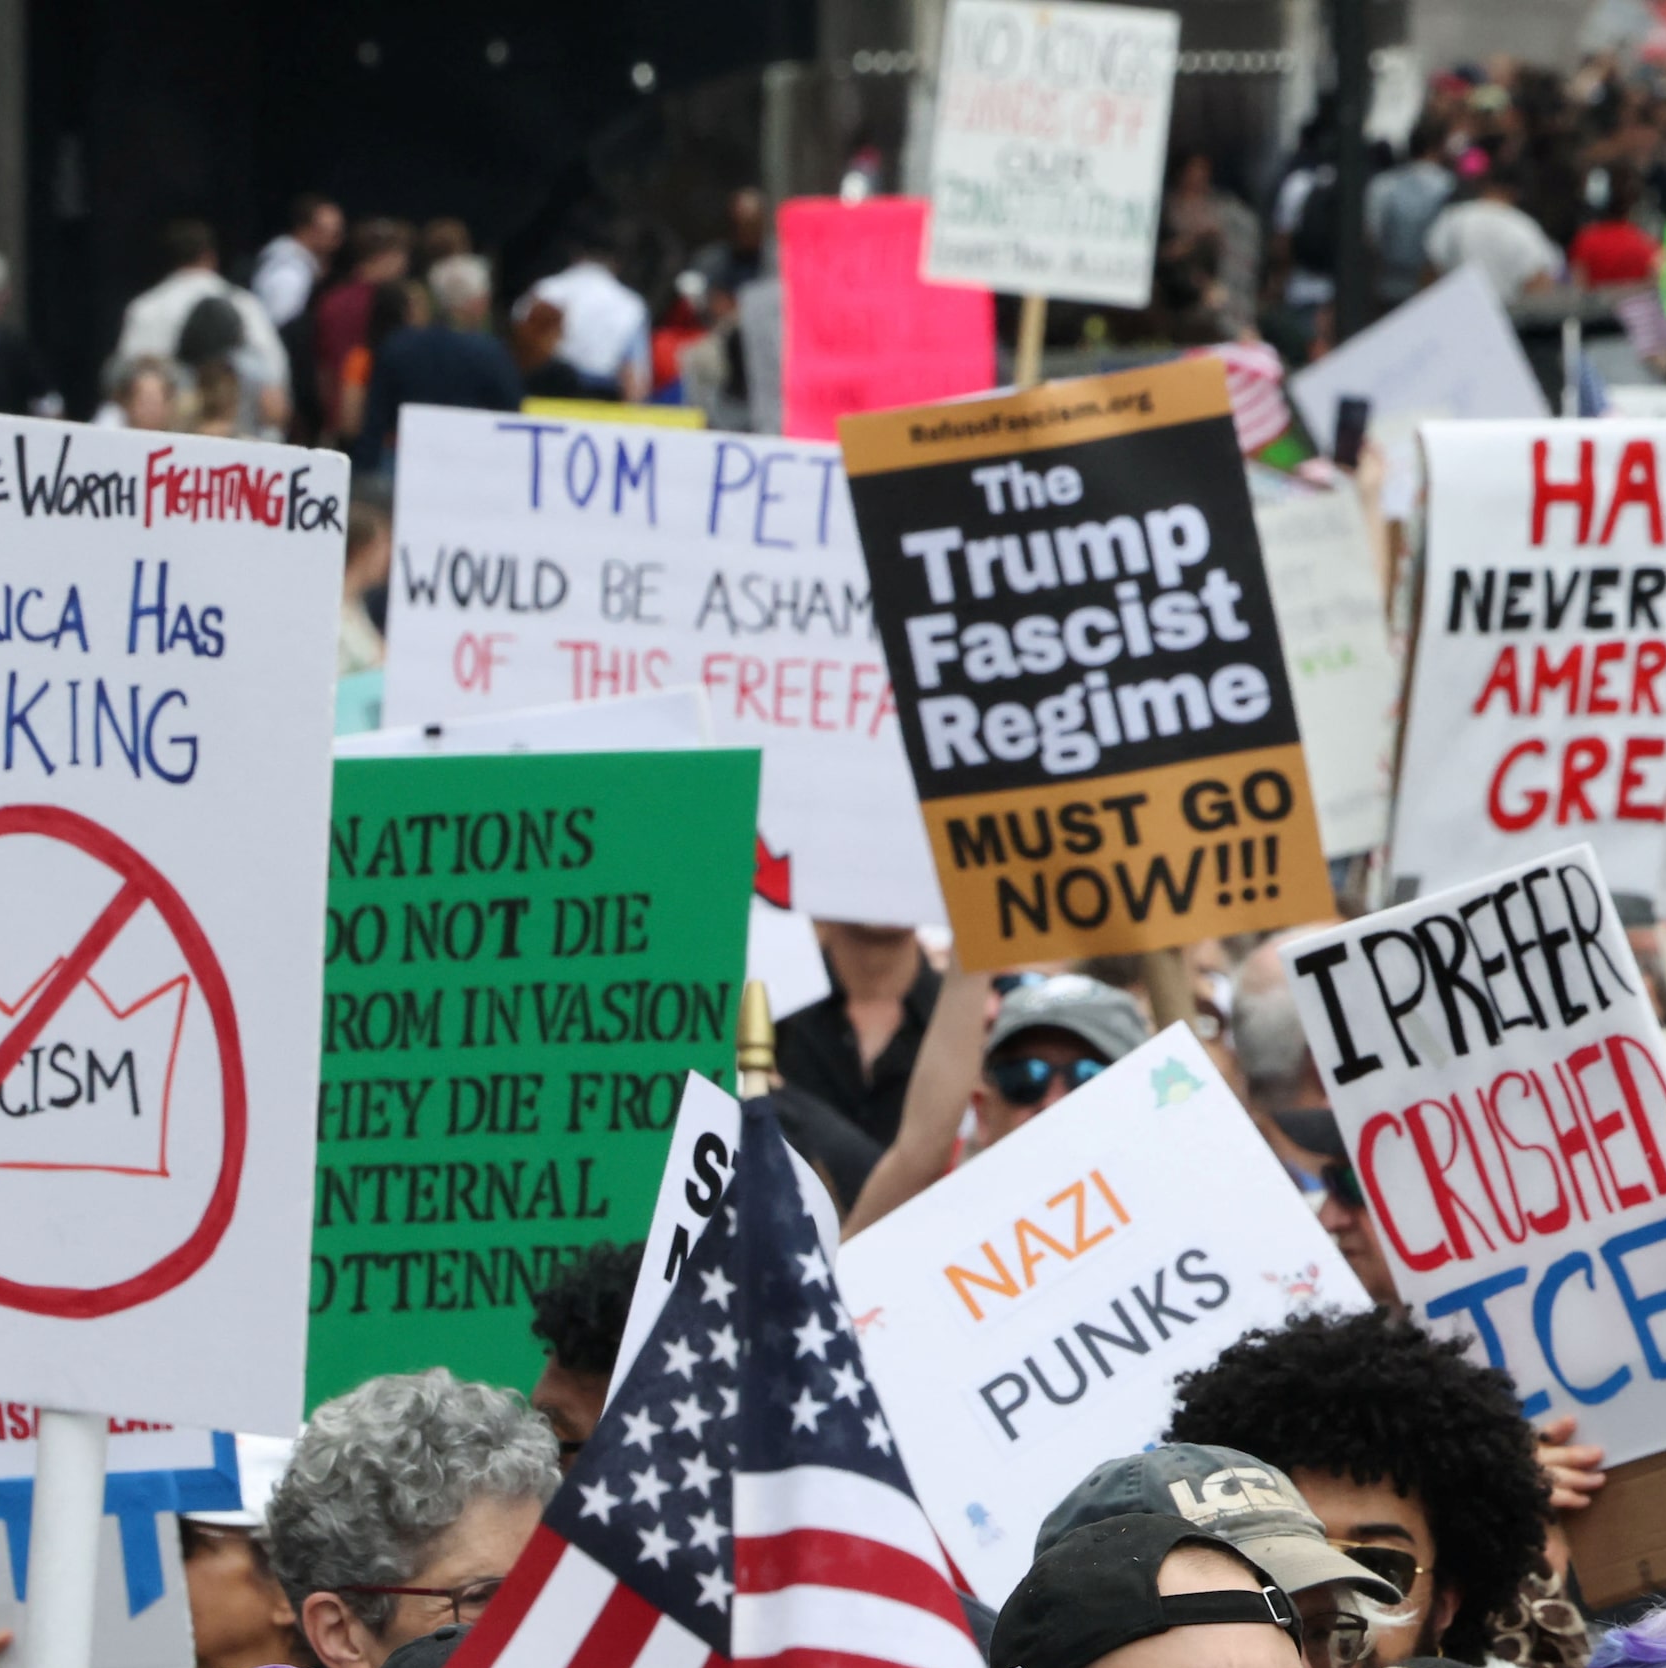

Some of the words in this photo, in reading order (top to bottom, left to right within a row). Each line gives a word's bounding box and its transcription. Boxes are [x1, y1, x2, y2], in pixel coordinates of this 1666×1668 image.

[495, 423, 659, 526] TOM
[972, 460, 1084, 515] The
[400, 545, 570, 615] WOULD
[599, 557, 669, 626] BE
[900, 503, 1211, 606] Trump
[129, 559, 226, 658] HAS
[905, 567, 1250, 690] Fascist
[452, 631, 517, 694] OF
[555, 639, 672, 702] THIS
[4, 670, 199, 785] KING
[917, 661, 1273, 777] Regime
[327, 807, 596, 881] NATIONS
[945, 794, 1149, 871] MUST
[1181, 769, 1295, 835] GO
[401, 897, 529, 966] NOT
[550, 893, 652, 959] DIE
[996, 834, 1281, 942] NOW!!!
[1294, 949, 1383, 1086] I
[1375, 864, 1637, 1068] PREFER
[445, 1074, 544, 1138] DIE
[941, 1168, 1134, 1324] NAZI
[976, 1247, 1232, 1443] PUNKS
